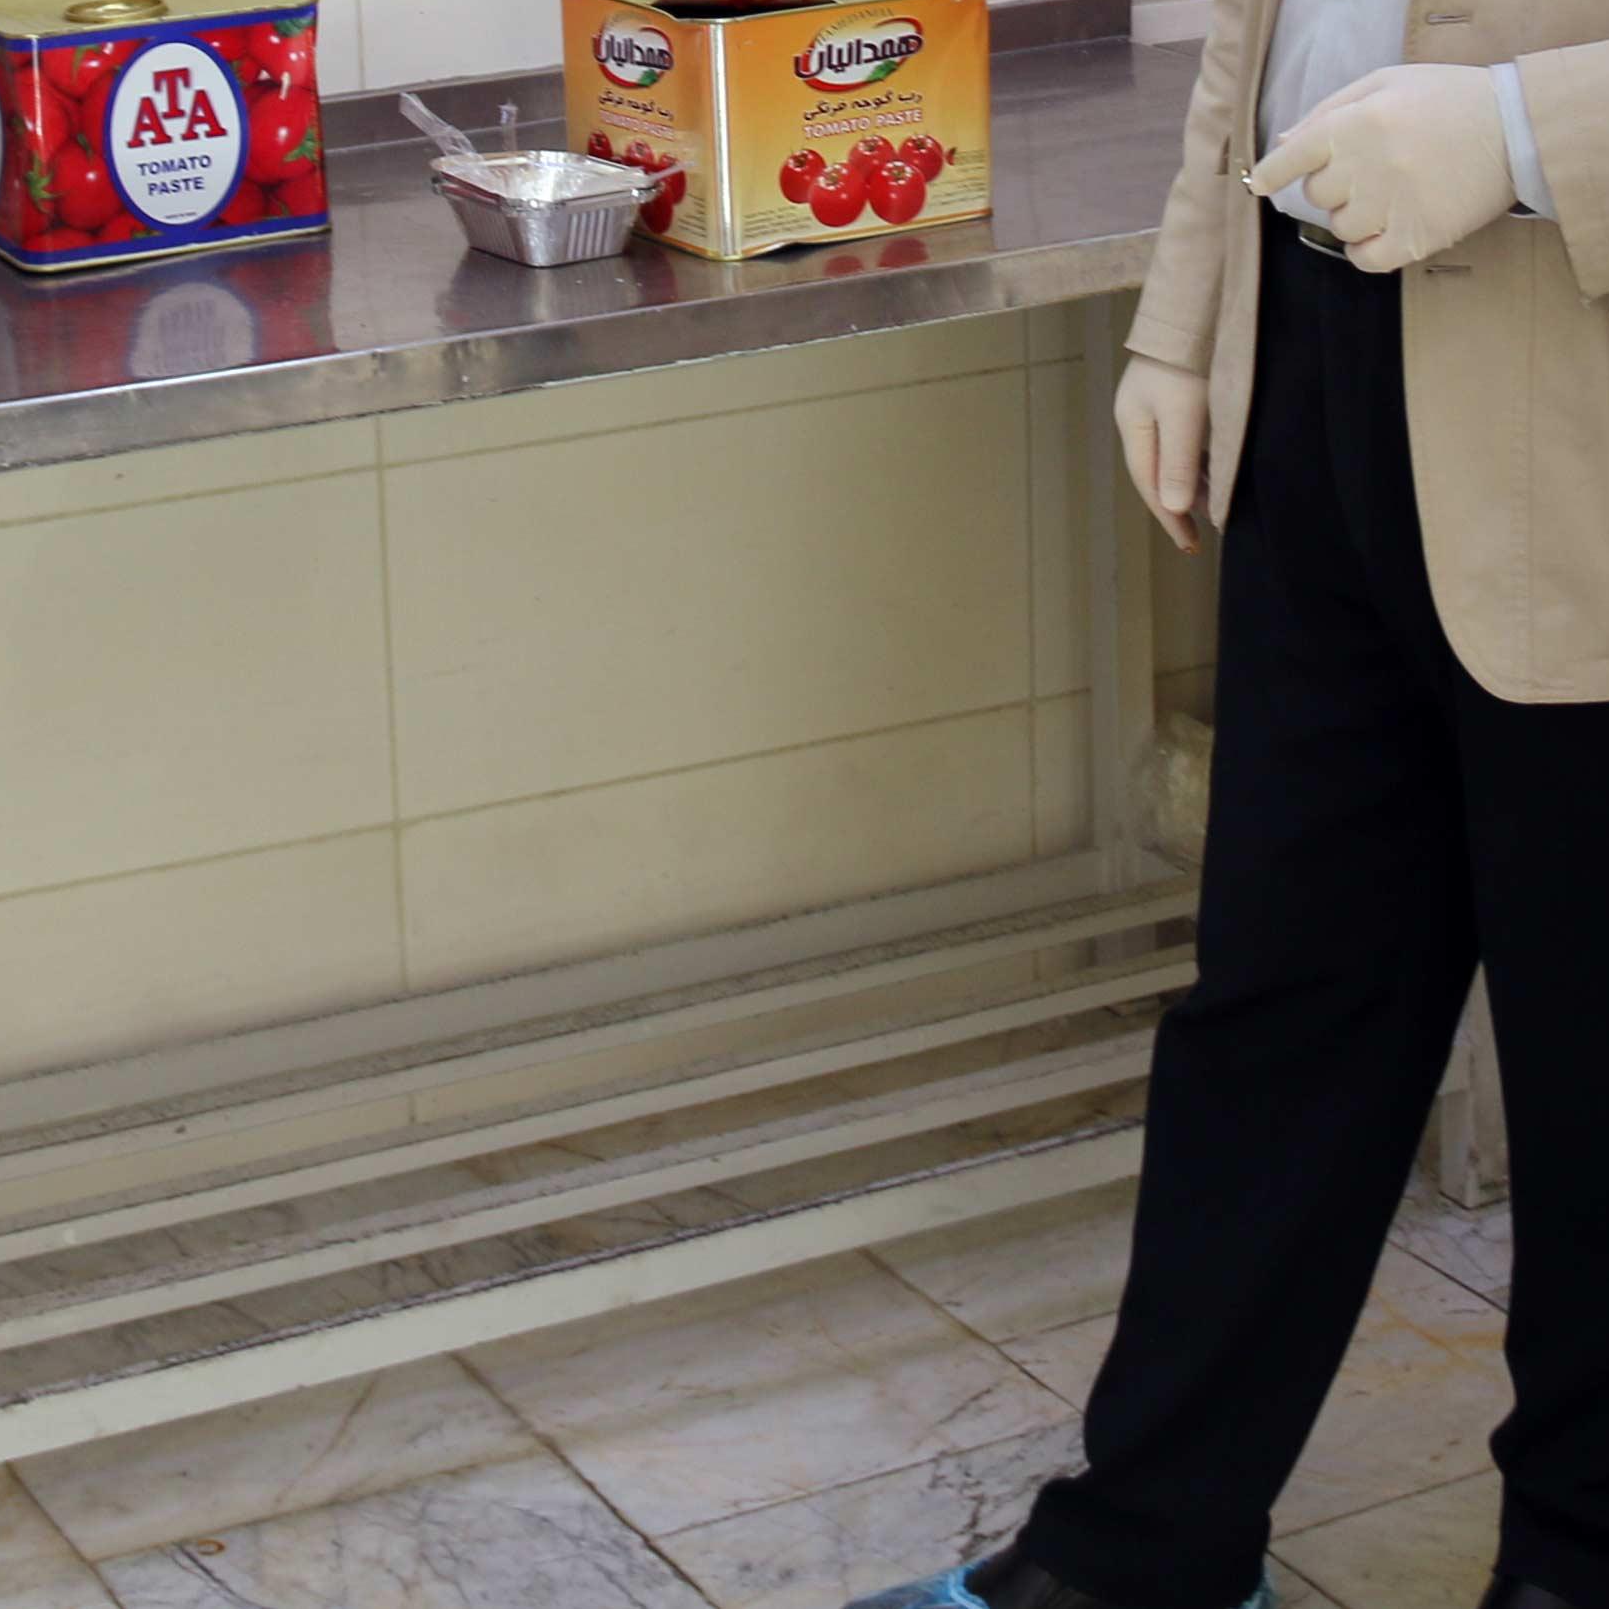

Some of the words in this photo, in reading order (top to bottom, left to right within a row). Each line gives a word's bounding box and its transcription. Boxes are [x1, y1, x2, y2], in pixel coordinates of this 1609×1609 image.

[793, 33, 923, 79] همدانیان
[127, 67, 227, 149] ATA
[803, 116, 871, 140] TOMATO
[876, 107, 924, 128] PASTE
[136, 154, 212, 177] TOMATO
[147, 176, 207, 197] PASTE
